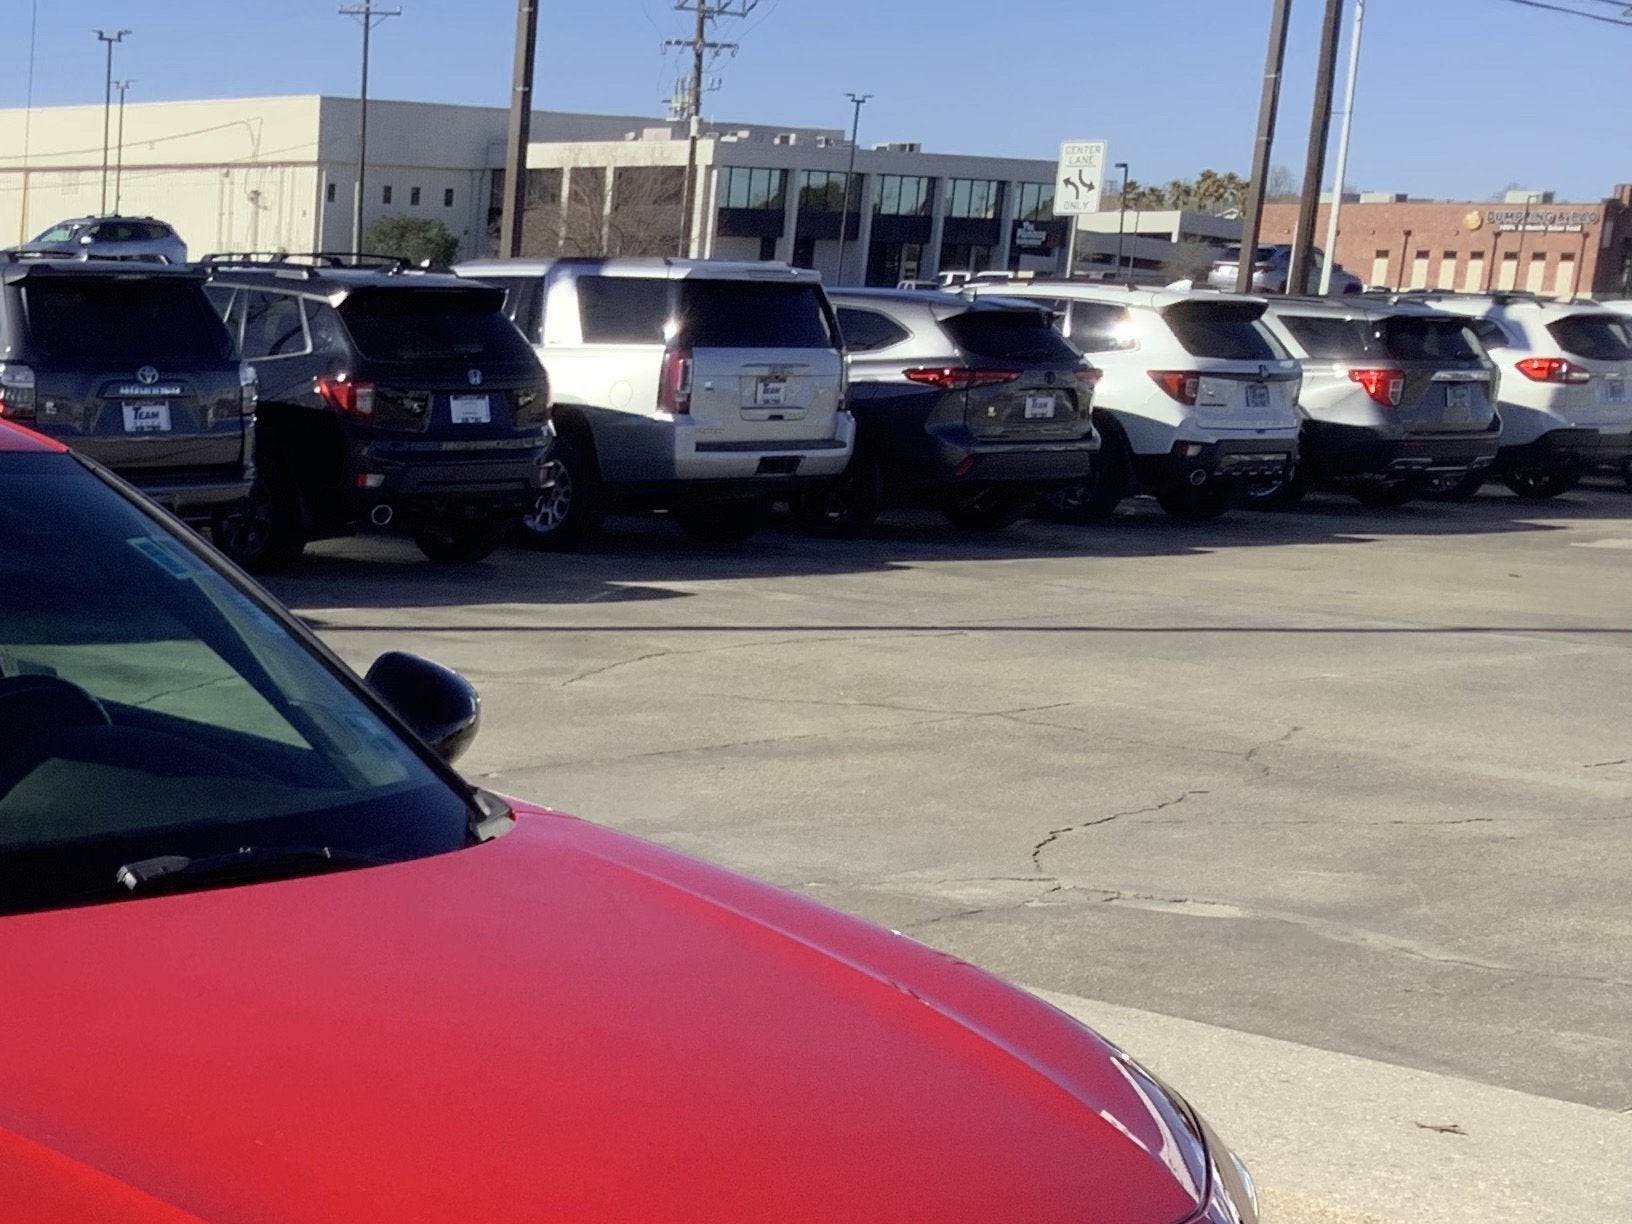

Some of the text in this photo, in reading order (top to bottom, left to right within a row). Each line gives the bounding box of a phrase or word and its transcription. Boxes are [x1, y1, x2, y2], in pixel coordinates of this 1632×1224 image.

[1066, 145, 1101, 154] CENTER
[1069, 155, 1094, 164] LANE
[1064, 201, 1088, 209] ONLY
